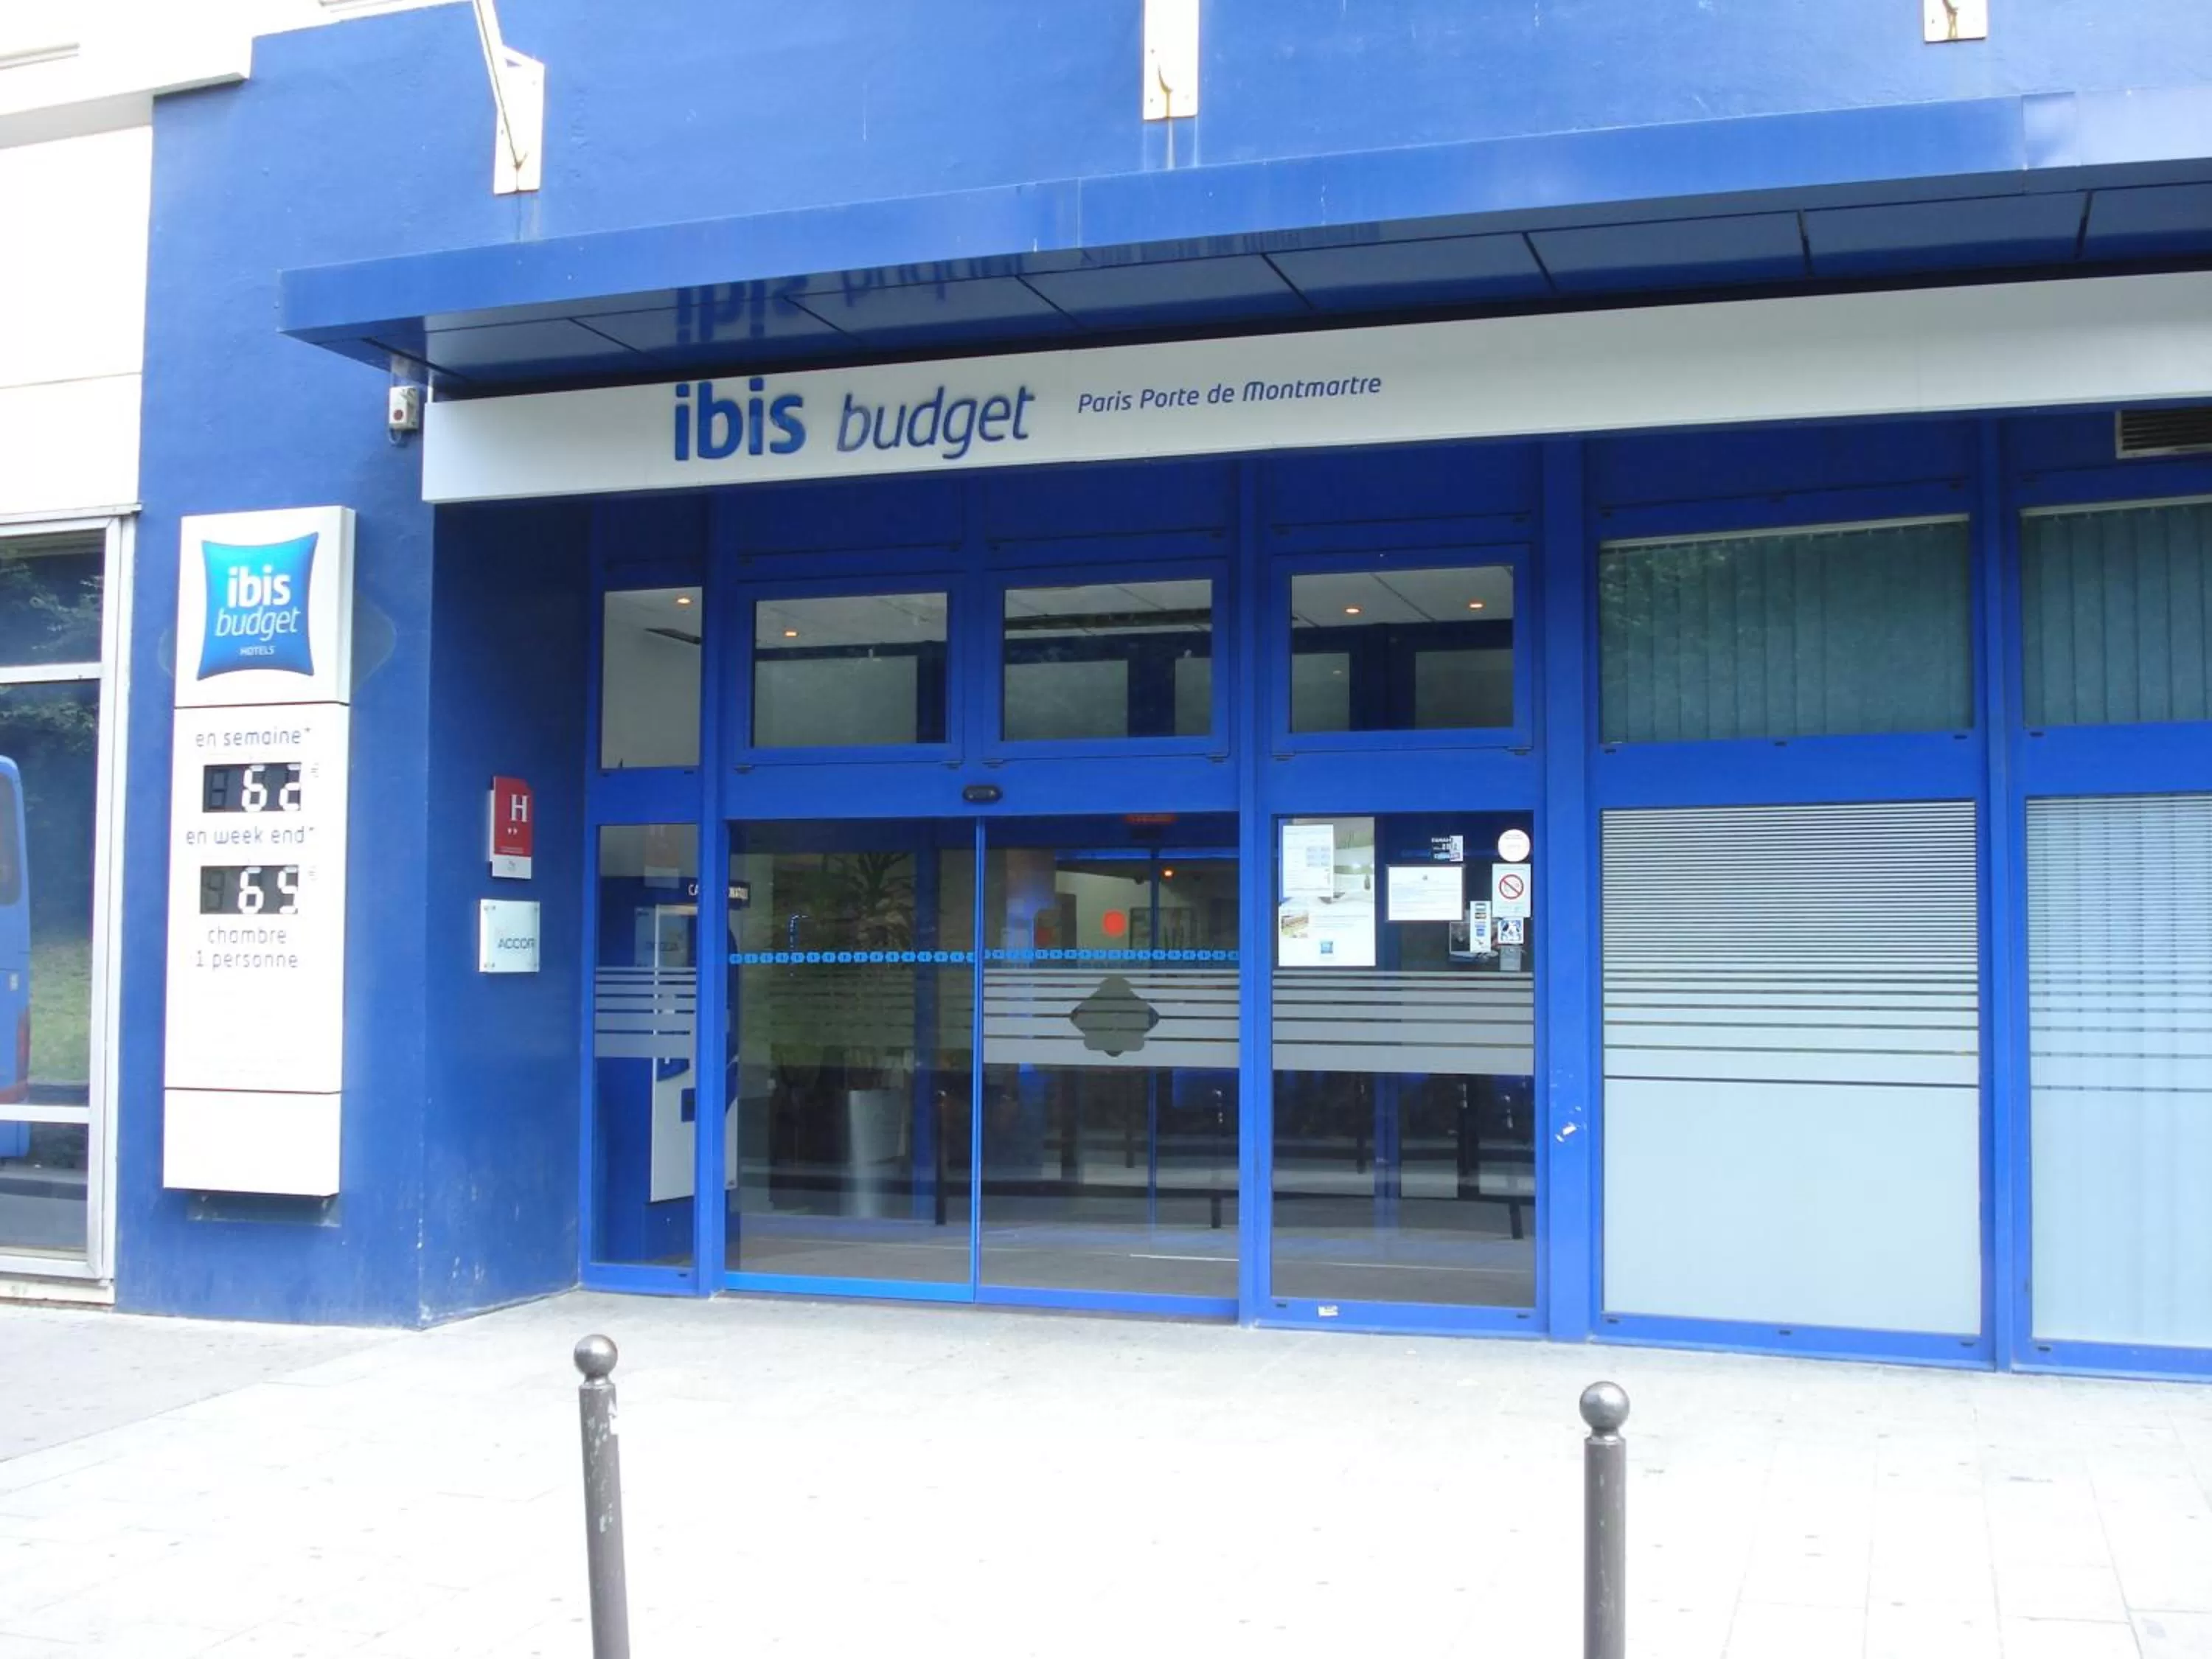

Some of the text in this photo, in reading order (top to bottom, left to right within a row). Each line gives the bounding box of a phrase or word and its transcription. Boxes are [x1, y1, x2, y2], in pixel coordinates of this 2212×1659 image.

[1077, 376, 1382, 414] Paris Porte de Montmartre
[675, 377, 1036, 461] ibis budget
[226, 564, 291, 608] ibis
[215, 606, 301, 641] budget
[239, 645, 276, 656] HOTELS
[195, 732, 217, 748] en
[510, 793, 529, 823] H
[186, 830, 207, 845] en
[214, 826, 263, 845] week
[208, 925, 288, 945] chambre
[497, 937, 536, 950] ACCOR
[212, 953, 299, 972] personne
